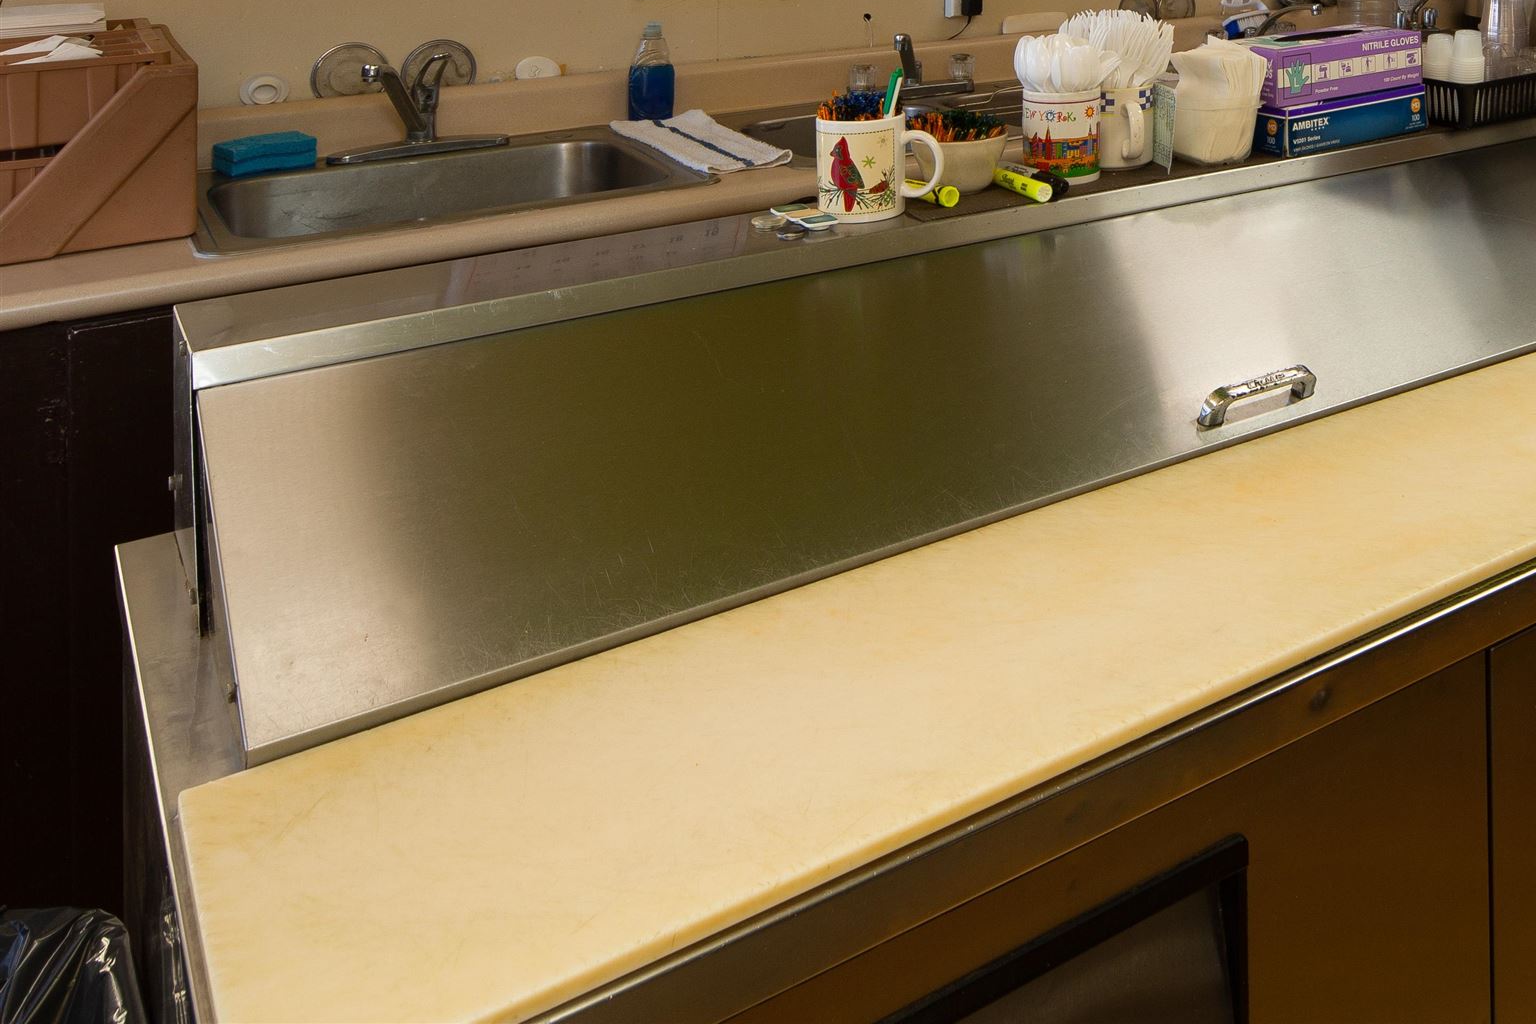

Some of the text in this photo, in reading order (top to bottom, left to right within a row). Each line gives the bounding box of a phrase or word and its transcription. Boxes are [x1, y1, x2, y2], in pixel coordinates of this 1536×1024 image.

[1362, 35, 1419, 52] NITRILE GLOVES
[1294, 79, 1300, 88] L
[1314, 87, 1328, 95] Powder
[1025, 107, 1077, 123] EW YORK
[1411, 114, 1420, 122] 100
[1292, 117, 1329, 132] AMBITEX
[1266, 136, 1276, 145] 100
[1307, 135, 1321, 143] Series
